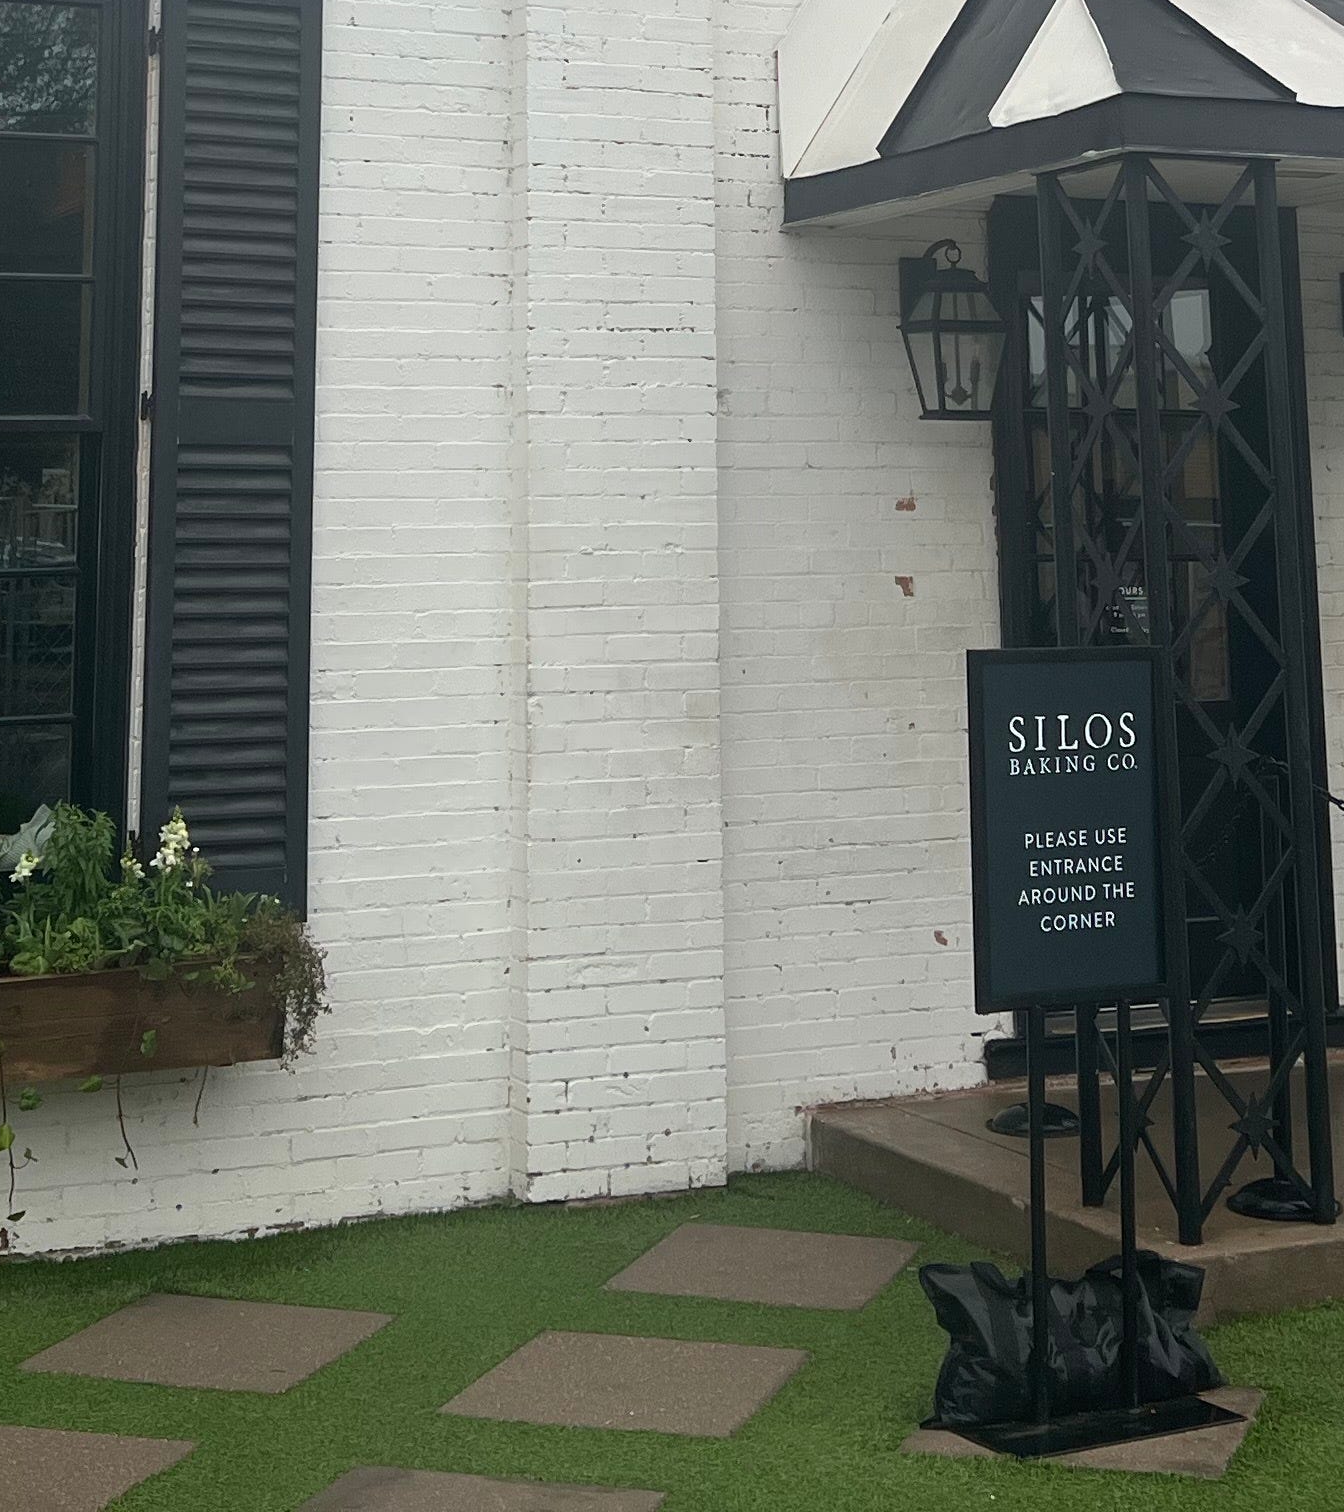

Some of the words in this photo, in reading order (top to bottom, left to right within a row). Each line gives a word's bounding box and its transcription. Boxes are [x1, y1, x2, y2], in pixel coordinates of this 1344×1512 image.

[1008, 711, 1137, 753] SILOS
[1009, 755, 1096, 775] BAKING
[1107, 753, 1138, 771] CO.
[1024, 829, 1088, 849] PLEASE
[1095, 827, 1127, 845] USE
[1029, 855, 1123, 877] ENTRANCE
[1018, 885, 1096, 906] AROUND
[1103, 882, 1135, 899] THE
[1040, 911, 1116, 932] CORNER
